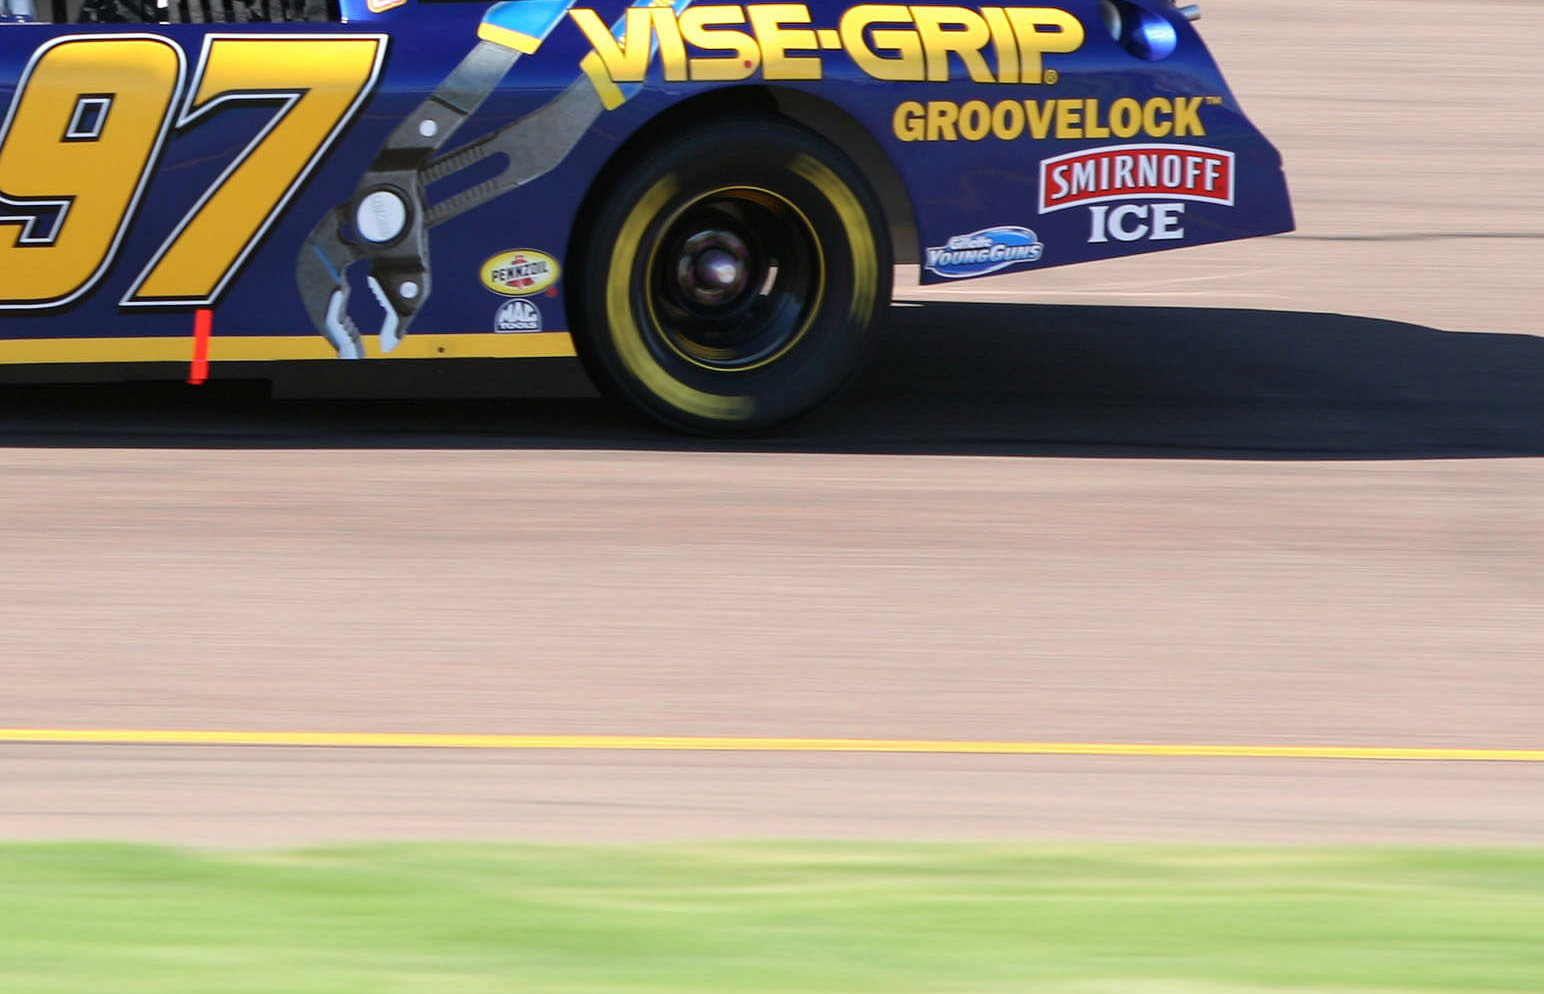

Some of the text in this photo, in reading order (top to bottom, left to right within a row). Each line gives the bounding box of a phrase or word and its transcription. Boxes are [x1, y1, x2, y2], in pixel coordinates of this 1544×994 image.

[569, 3, 1086, 84] VISE-GRIP
[892, 96, 1206, 142] GROOVELOCK
[1050, 153, 1223, 201] SMIRNOFF
[1087, 202, 1186, 243] ICE
[491, 260, 549, 283] PENNZOIL
